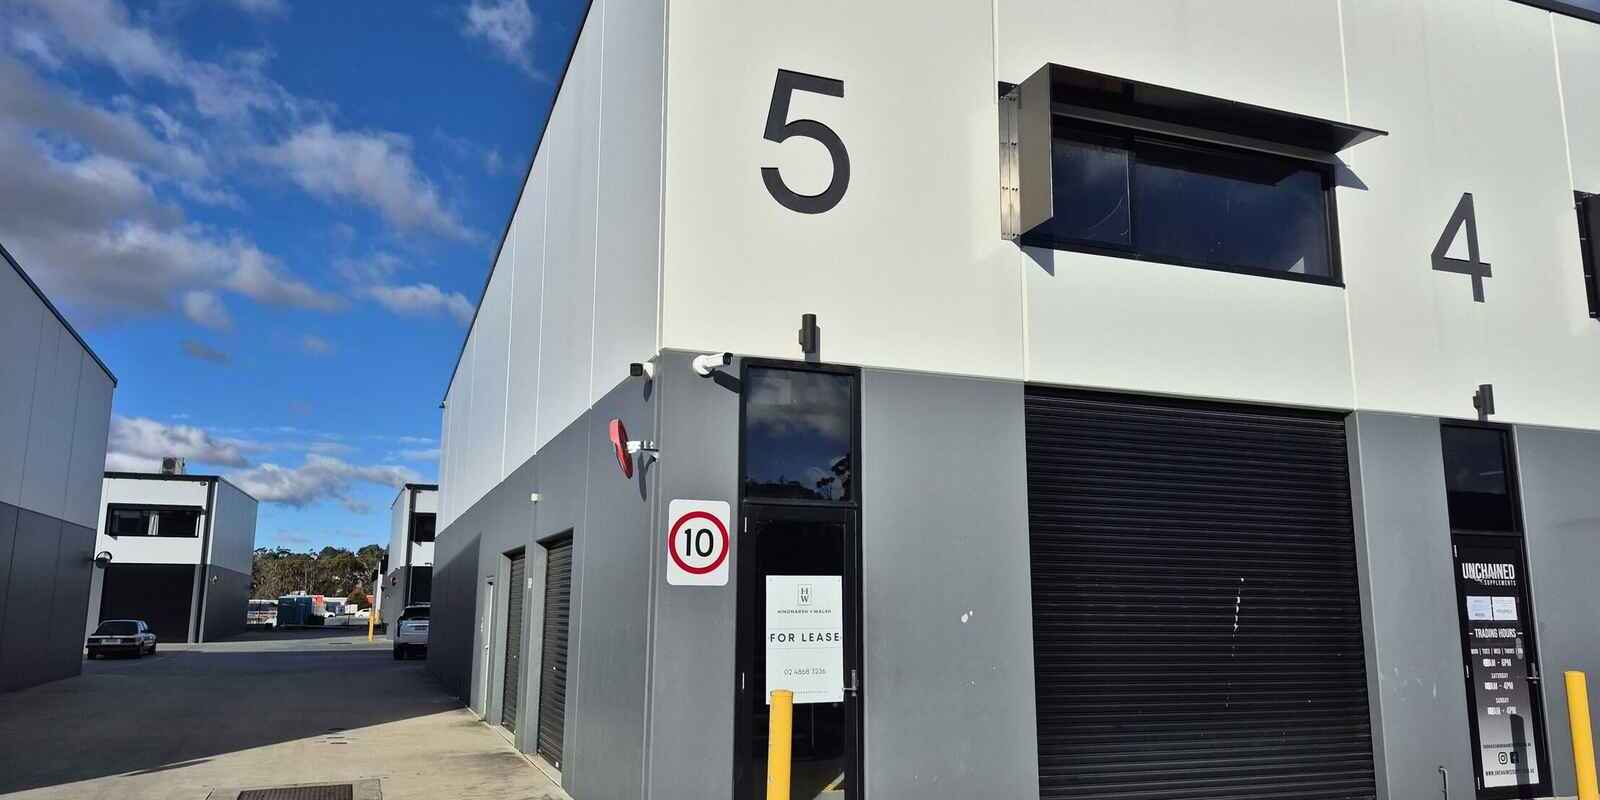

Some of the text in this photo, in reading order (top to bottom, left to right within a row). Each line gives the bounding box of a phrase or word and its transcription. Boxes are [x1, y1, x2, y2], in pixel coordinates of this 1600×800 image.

[761, 68, 850, 214] 5
[1431, 192, 1492, 303] 4
[684, 528, 714, 558] 10
[1462, 562, 1515, 581] UNCHAINED
[1483, 579, 1517, 587] SUPPLEMENTS
[801, 595, 809, 603] W
[770, 632, 840, 643] FOR LEASE
[1474, 628, 1517, 638] TRADING HOURS
[784, 668, 793, 676] 02
